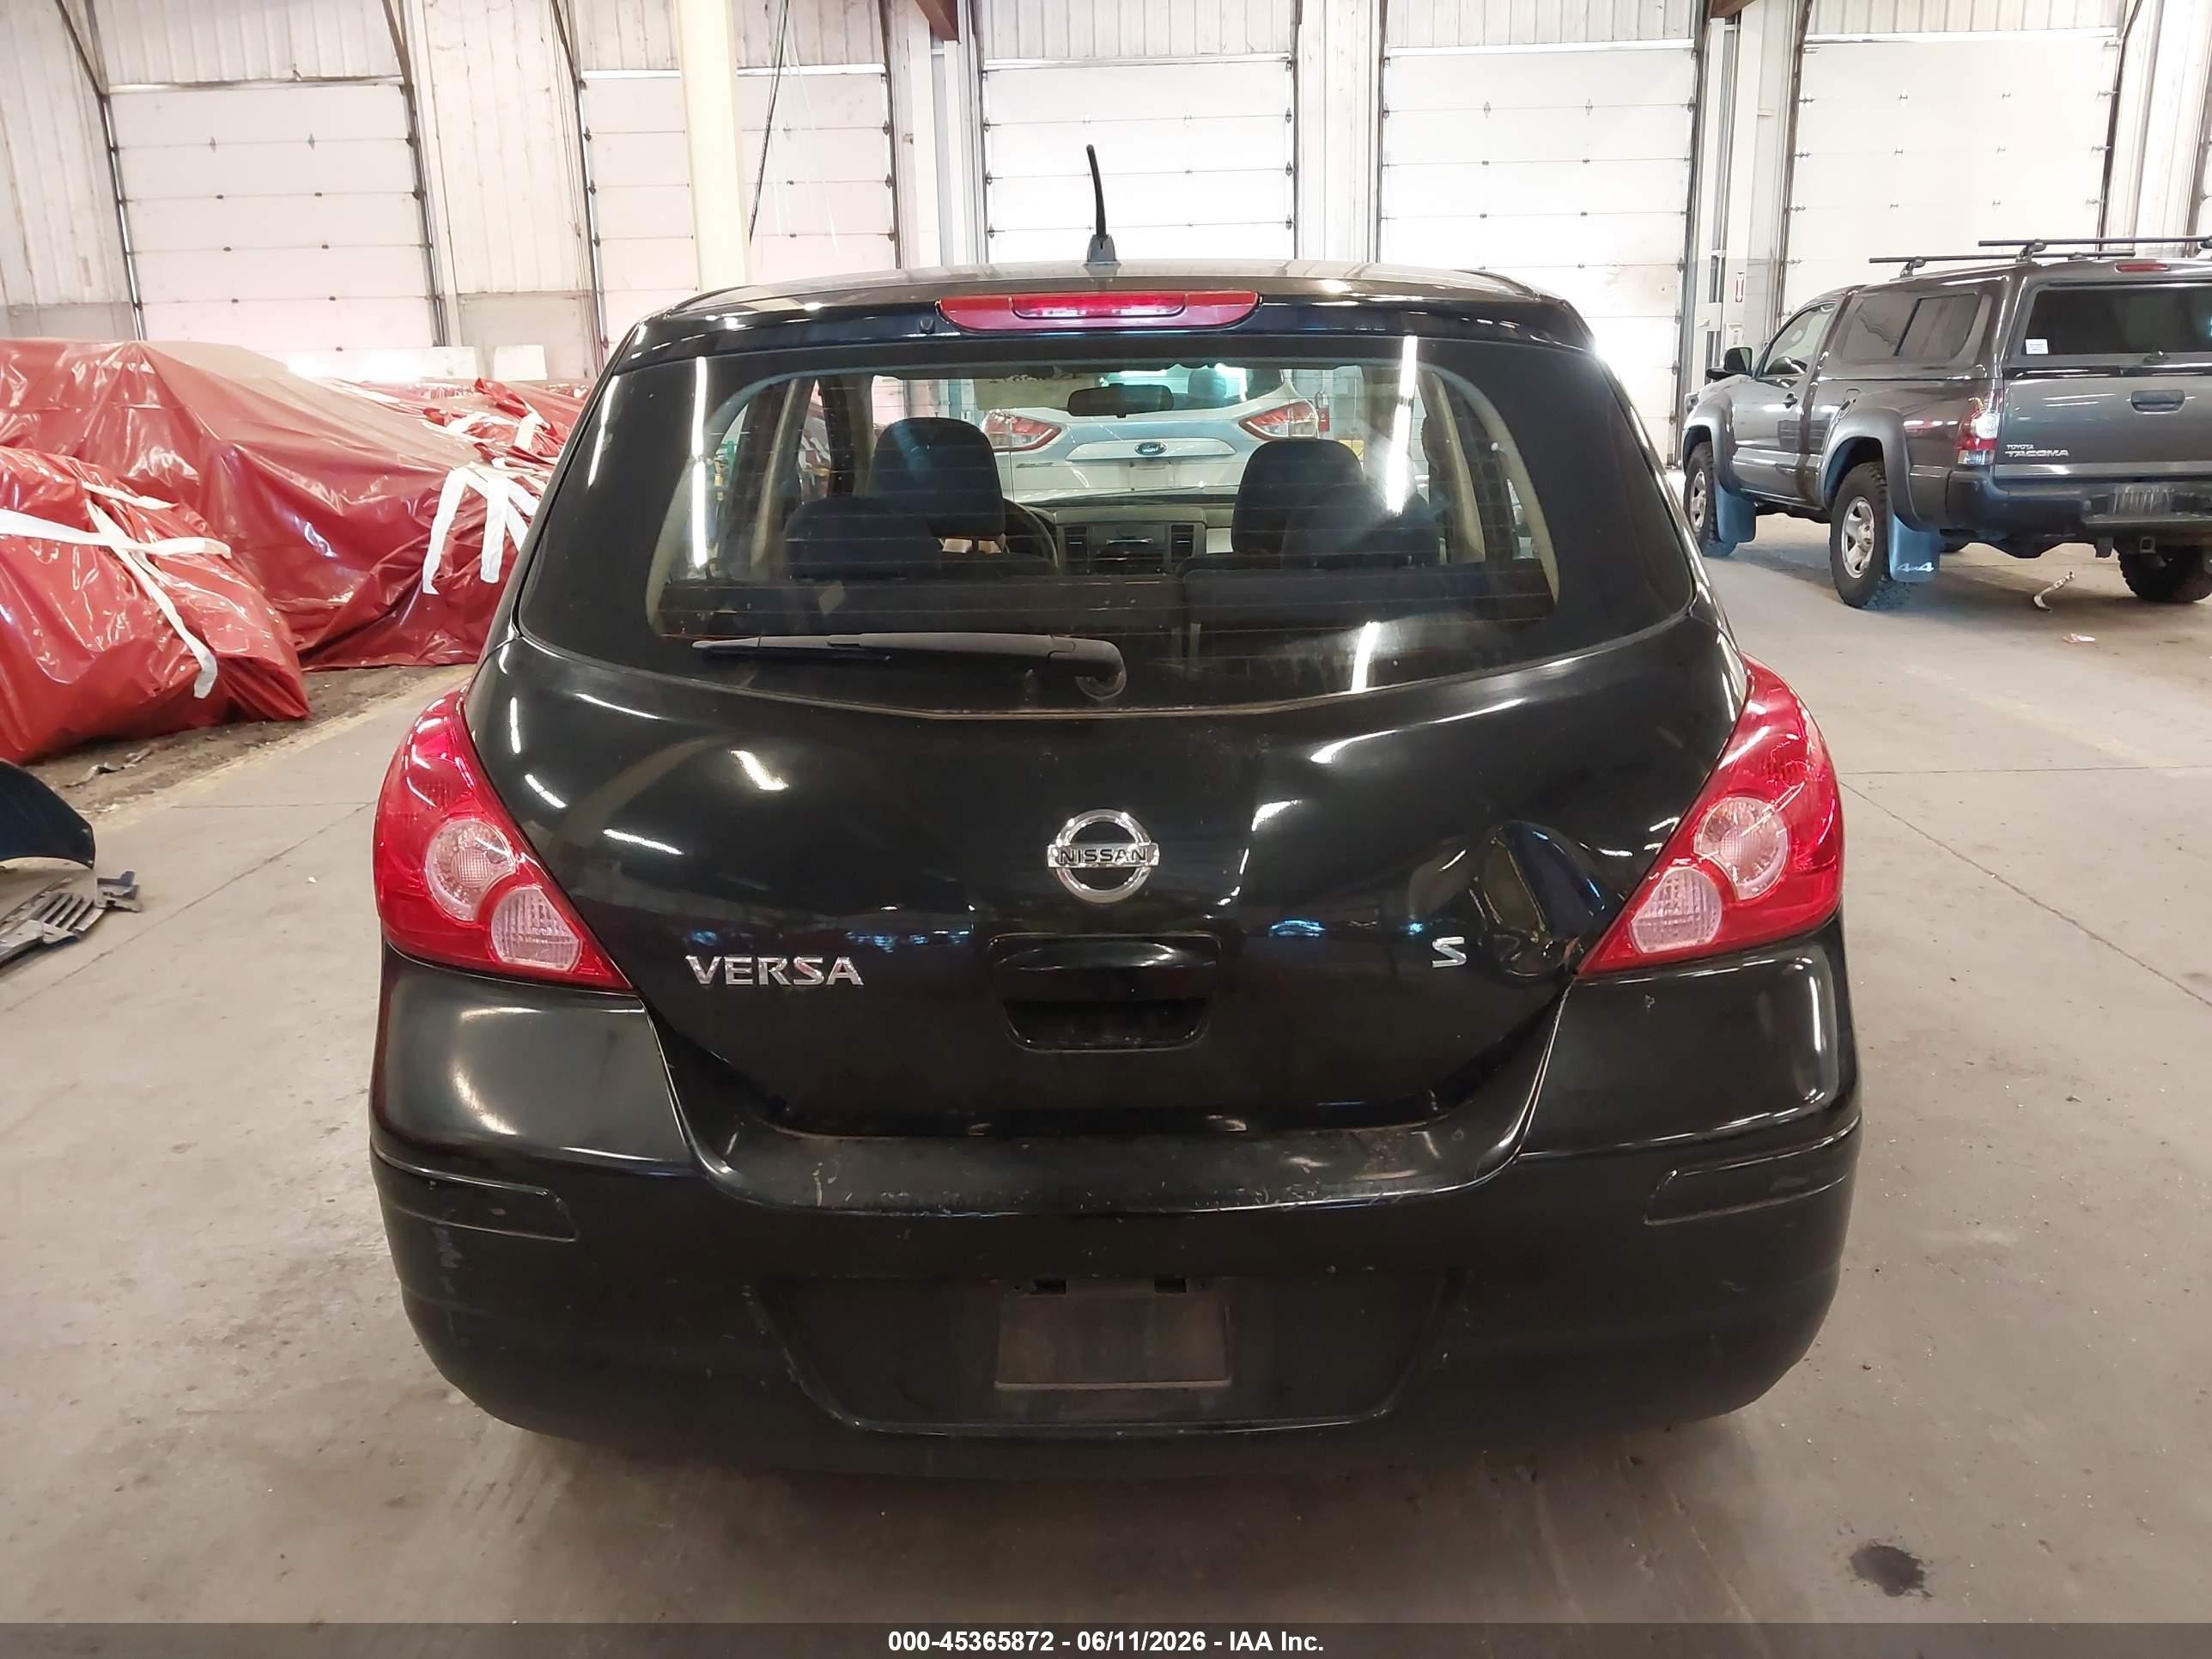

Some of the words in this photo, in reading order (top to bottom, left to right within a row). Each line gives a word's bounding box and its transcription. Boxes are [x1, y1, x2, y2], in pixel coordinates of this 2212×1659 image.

[2004, 449, 2069, 458] TACOMA
[1059, 848, 1147, 864] NISSAN
[1431, 936, 1467, 969] S
[685, 956, 865, 986] VERSA
